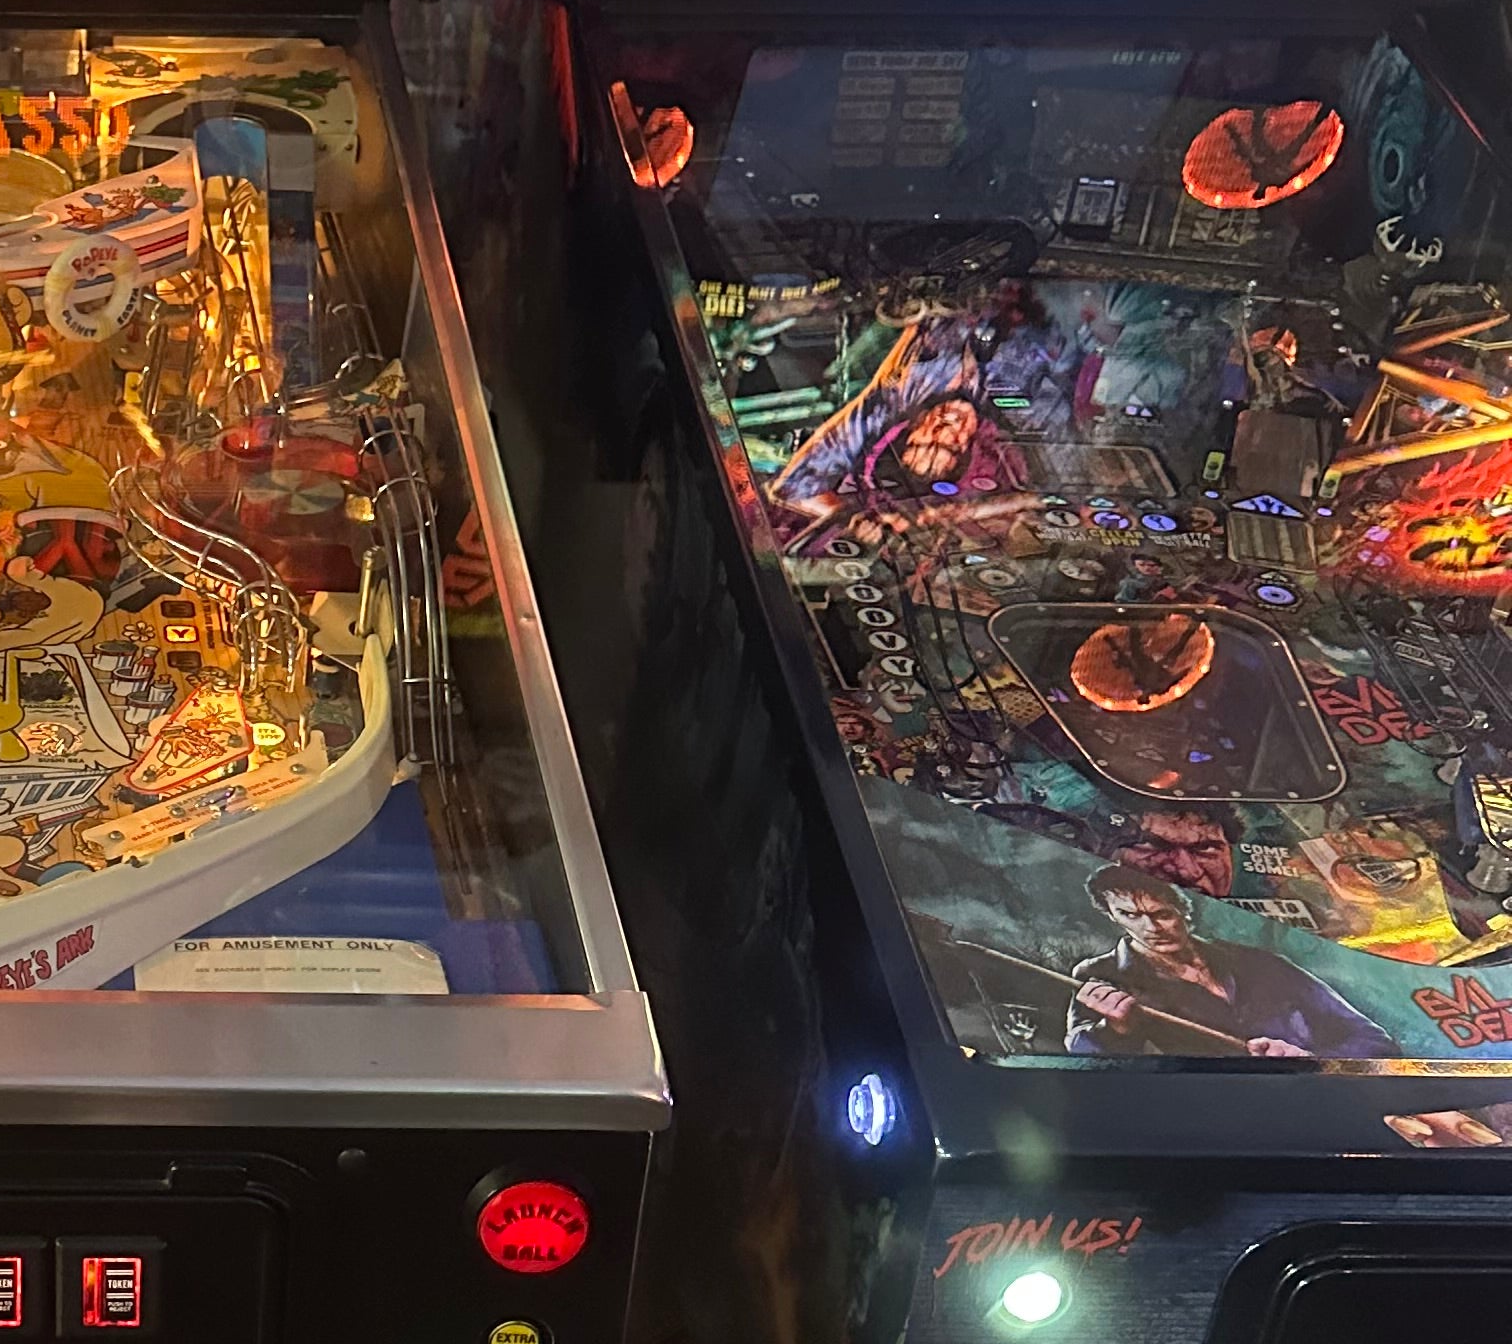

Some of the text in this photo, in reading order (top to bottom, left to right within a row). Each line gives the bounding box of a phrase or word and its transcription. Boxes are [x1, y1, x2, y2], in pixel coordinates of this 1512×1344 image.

[71, 246, 118, 272] POPEYE
[1089, 529, 1143, 540] CELLAR
[1240, 843, 1291, 858] COME
[1250, 853, 1284, 866] GET
[56, 925, 95, 969] ARK
[174, 940, 395, 952] FOR AMUSEMENT ONLY
[1413, 973, 1512, 1020] EVIL
[485, 1202, 585, 1235] LAUNCH
[933, 1211, 1143, 1278] JOIN US!
[502, 1244, 561, 1262] BALL
[107, 1279, 133, 1289] TOKEN
[496, 1332, 537, 1344] EXTRA
